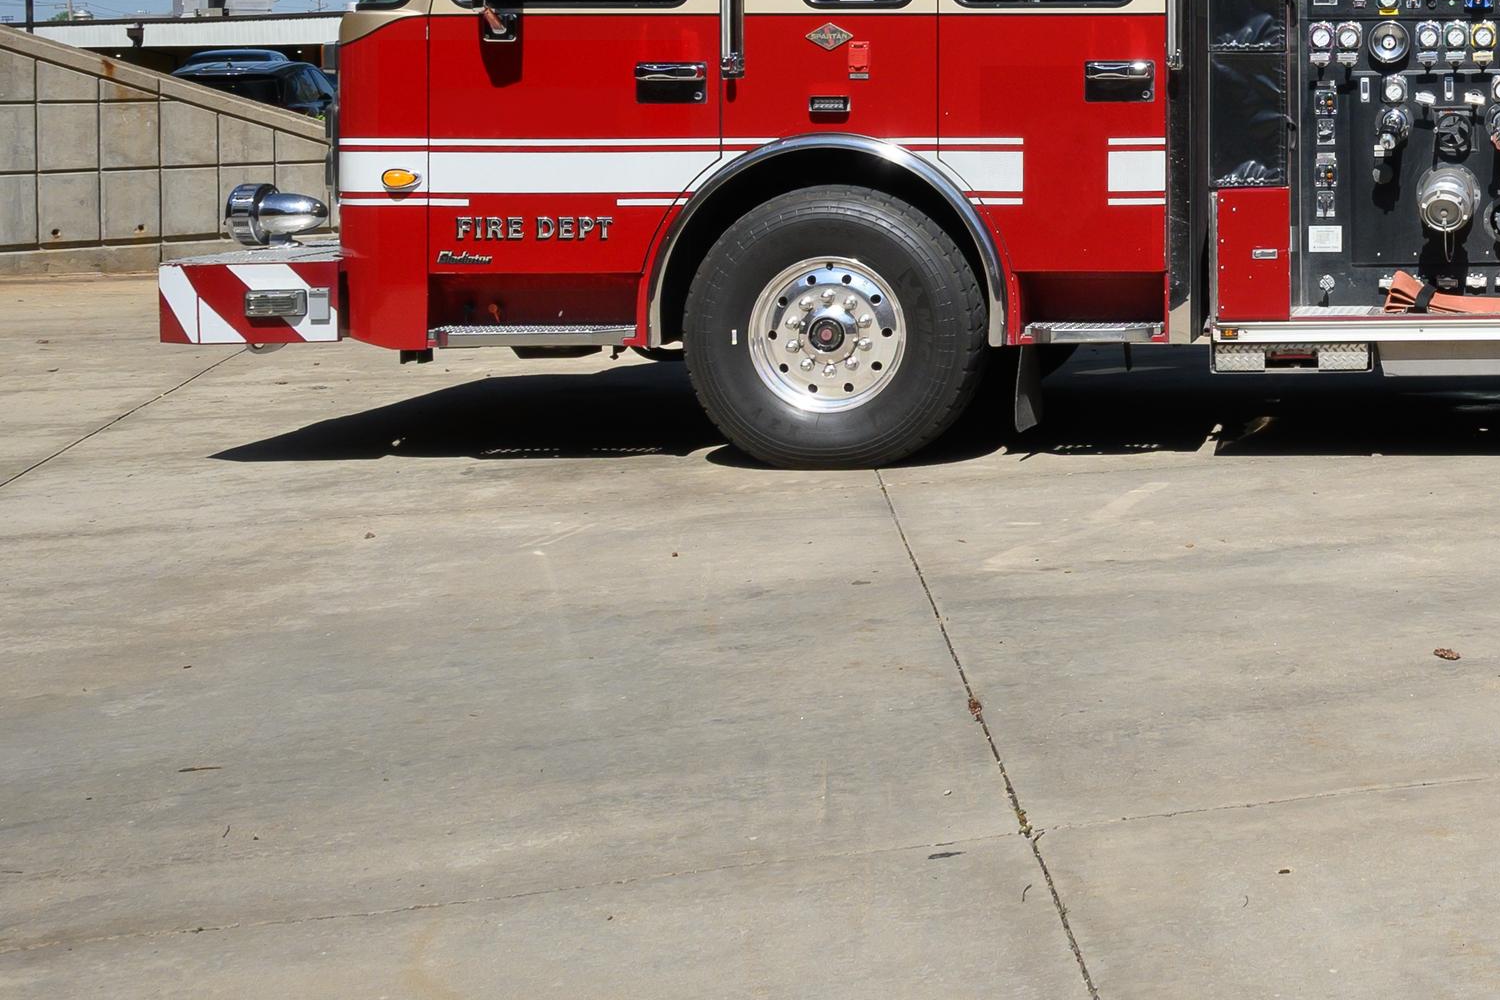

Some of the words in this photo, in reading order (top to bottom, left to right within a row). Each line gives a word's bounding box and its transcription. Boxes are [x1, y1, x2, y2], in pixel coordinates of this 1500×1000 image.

[810, 31, 848, 41] SPARTAN
[456, 216, 525, 240] FIRE
[535, 216, 614, 240] DEPT
[437, 250, 493, 265] Gladiator
